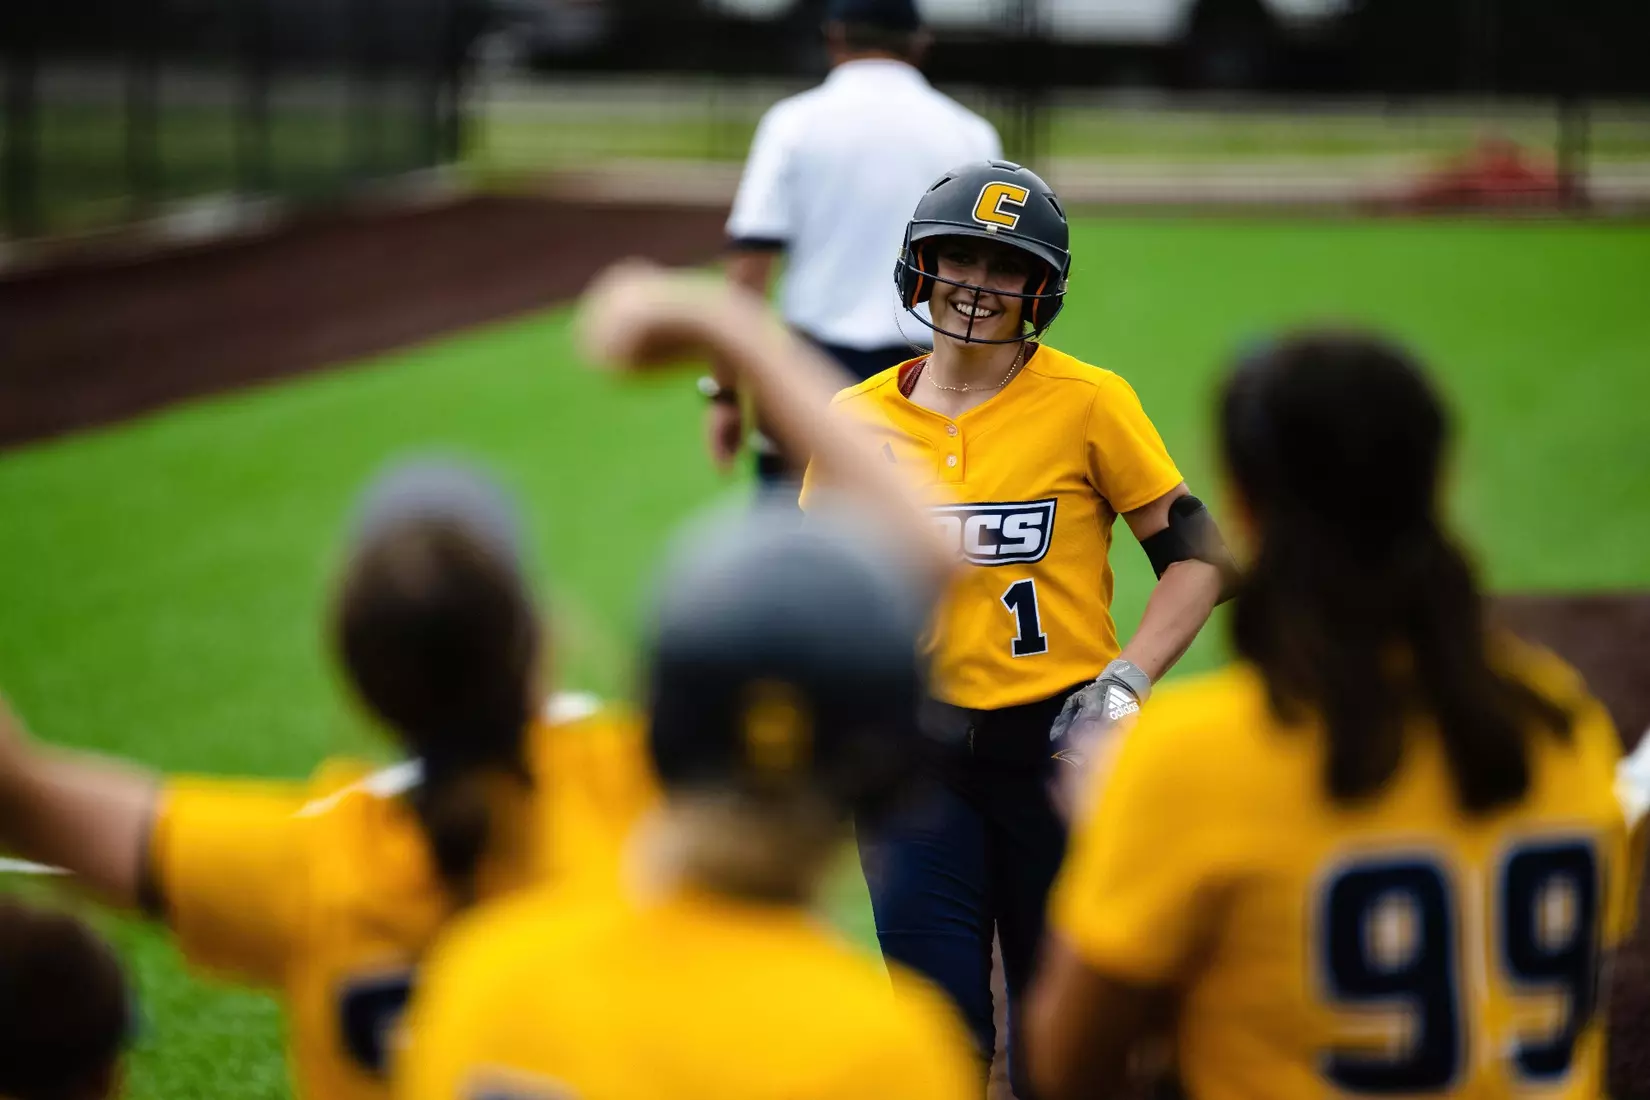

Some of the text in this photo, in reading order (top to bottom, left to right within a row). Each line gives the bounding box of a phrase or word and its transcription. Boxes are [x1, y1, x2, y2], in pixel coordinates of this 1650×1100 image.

[972, 181, 1030, 230] C
[928, 511, 1045, 556] OCS
[1000, 577, 1048, 658] 1
[1109, 701, 1140, 720] adidas
[1321, 838, 1600, 1093] 99
